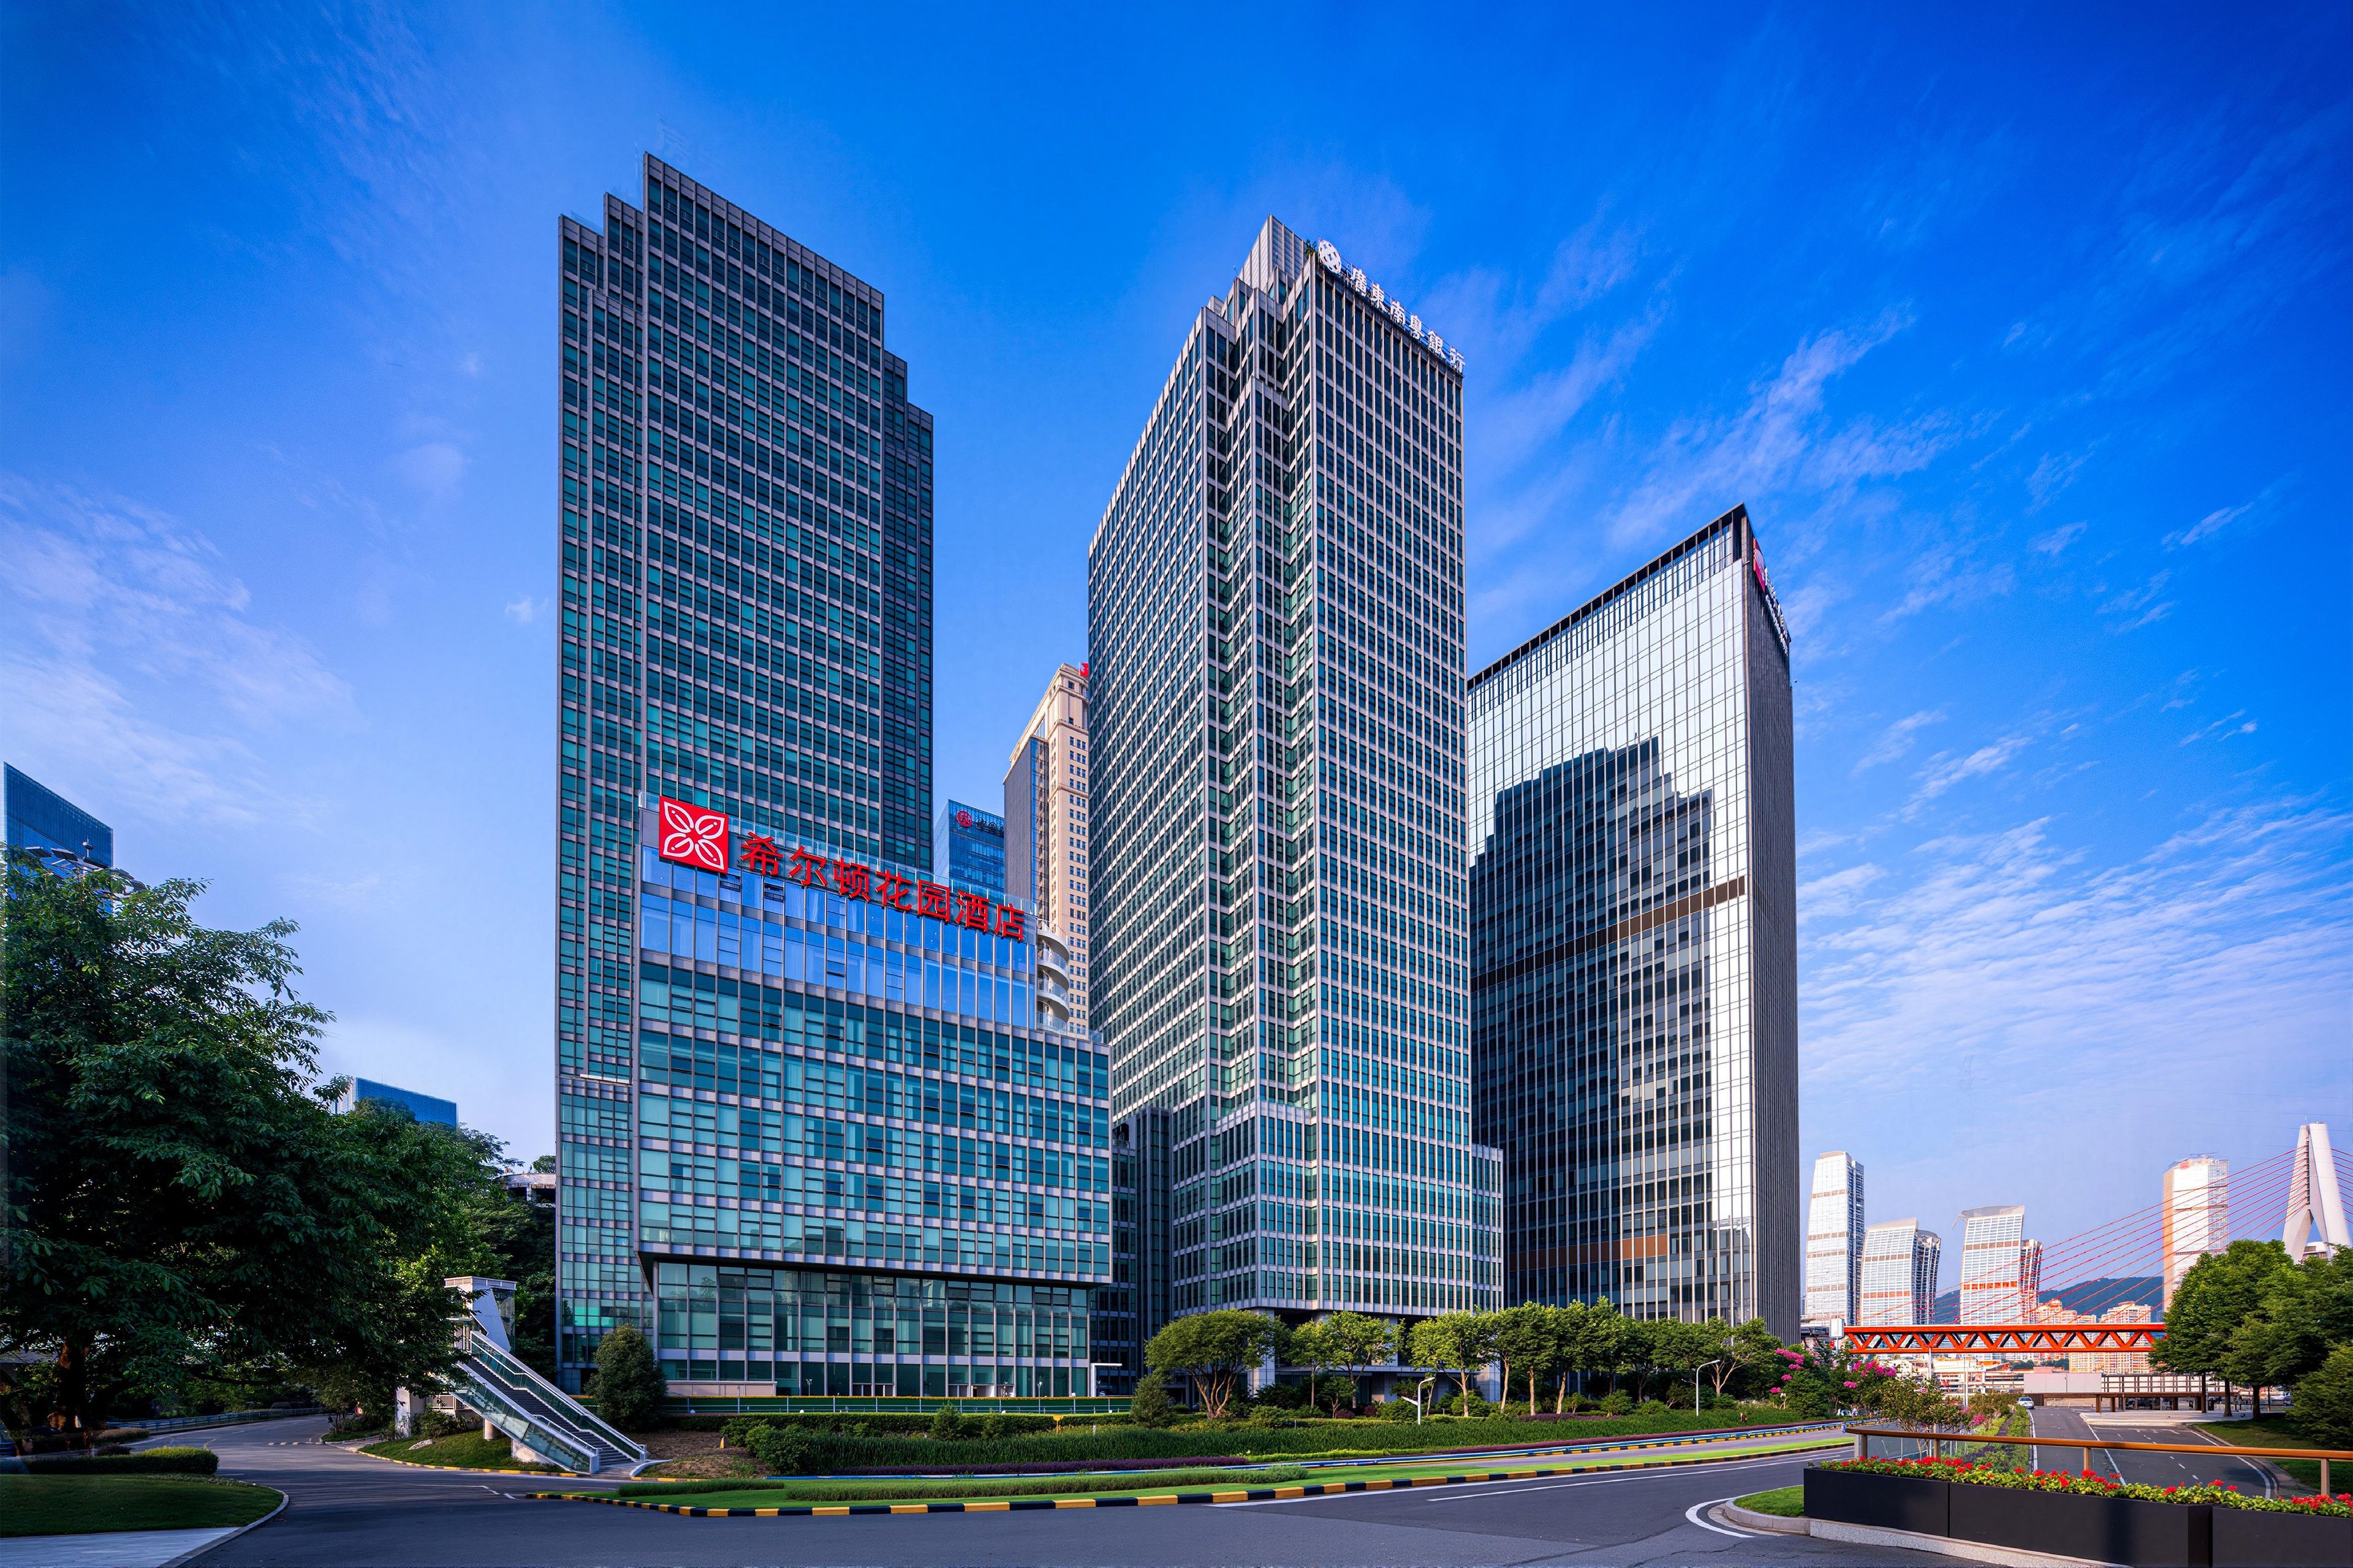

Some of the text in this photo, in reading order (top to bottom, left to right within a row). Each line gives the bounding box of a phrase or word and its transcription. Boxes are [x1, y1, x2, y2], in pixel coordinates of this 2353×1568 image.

[740, 831, 1026, 942] 希尔顿花园酒店
